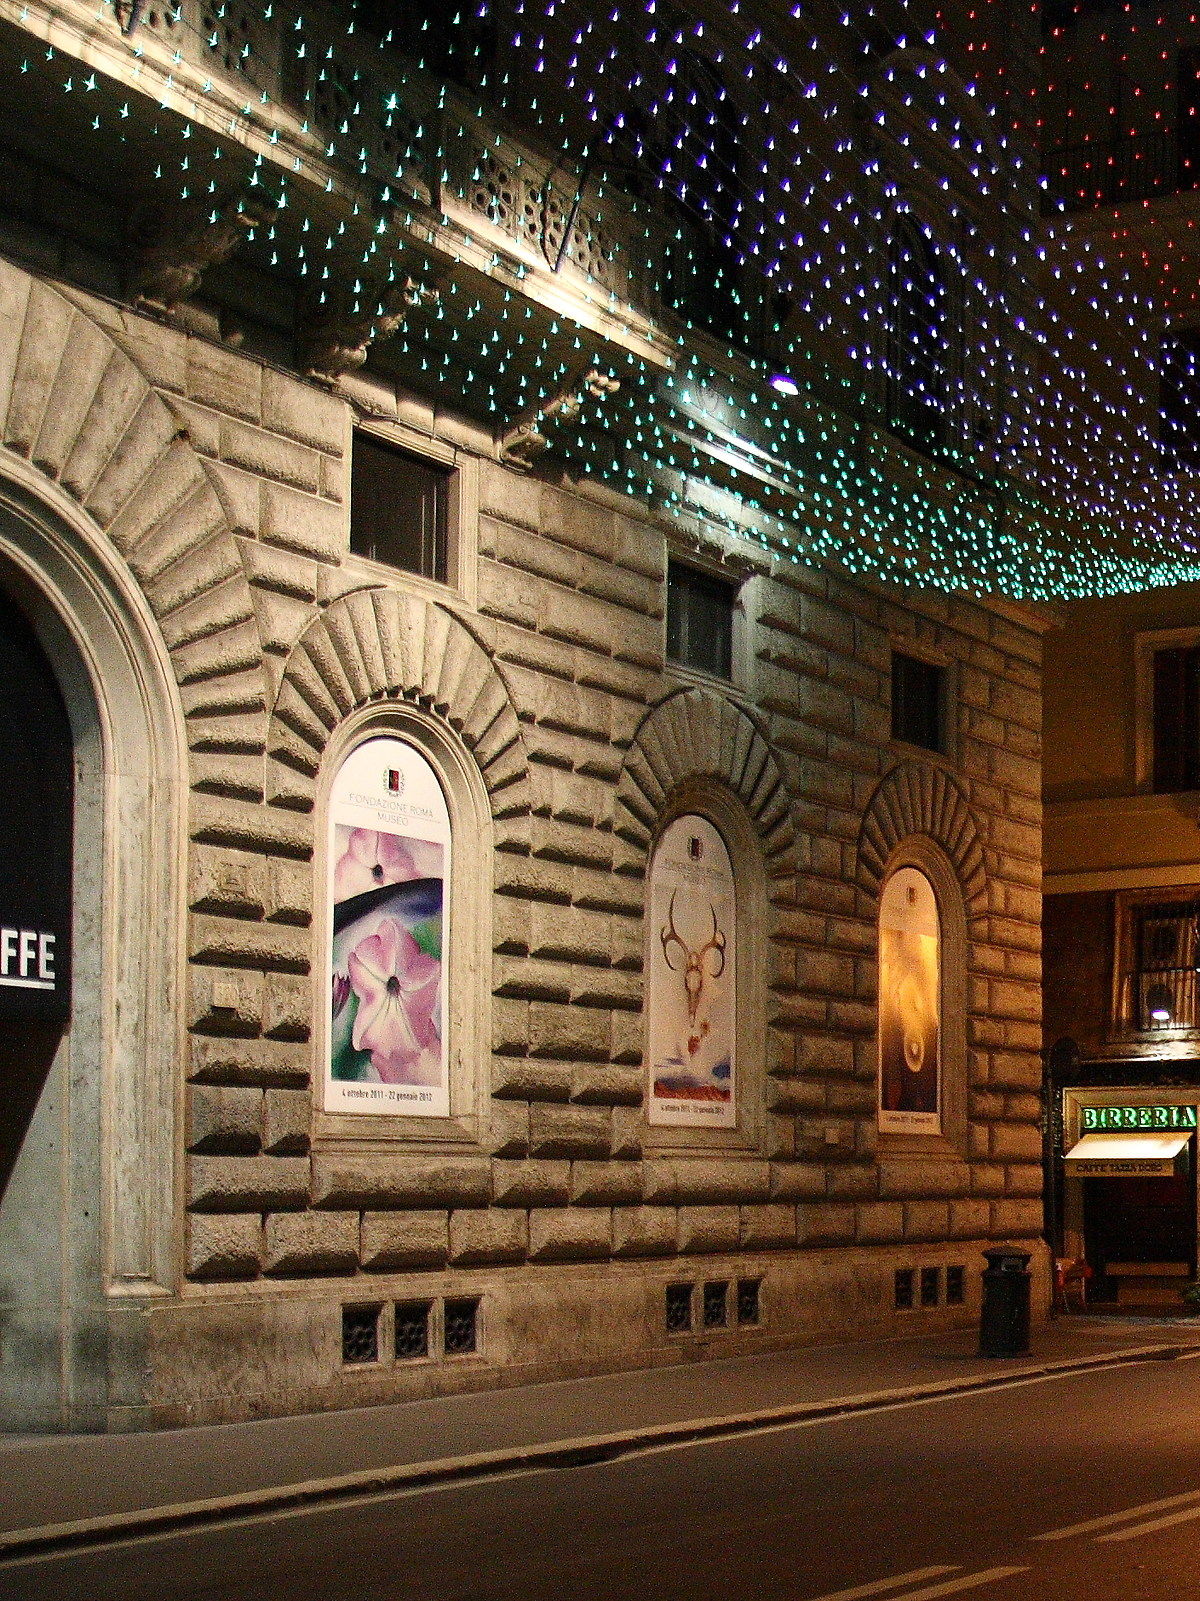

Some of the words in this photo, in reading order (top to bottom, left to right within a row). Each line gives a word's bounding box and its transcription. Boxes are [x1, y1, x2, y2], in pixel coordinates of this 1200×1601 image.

[349, 792, 408, 813] FONDAZIONE
[409, 804, 434, 818] ROMA
[377, 811, 409, 826] MUSEO
[347, 1089, 369, 1098] ottobre
[1083, 1106, 1197, 1129] BIRRERIA
